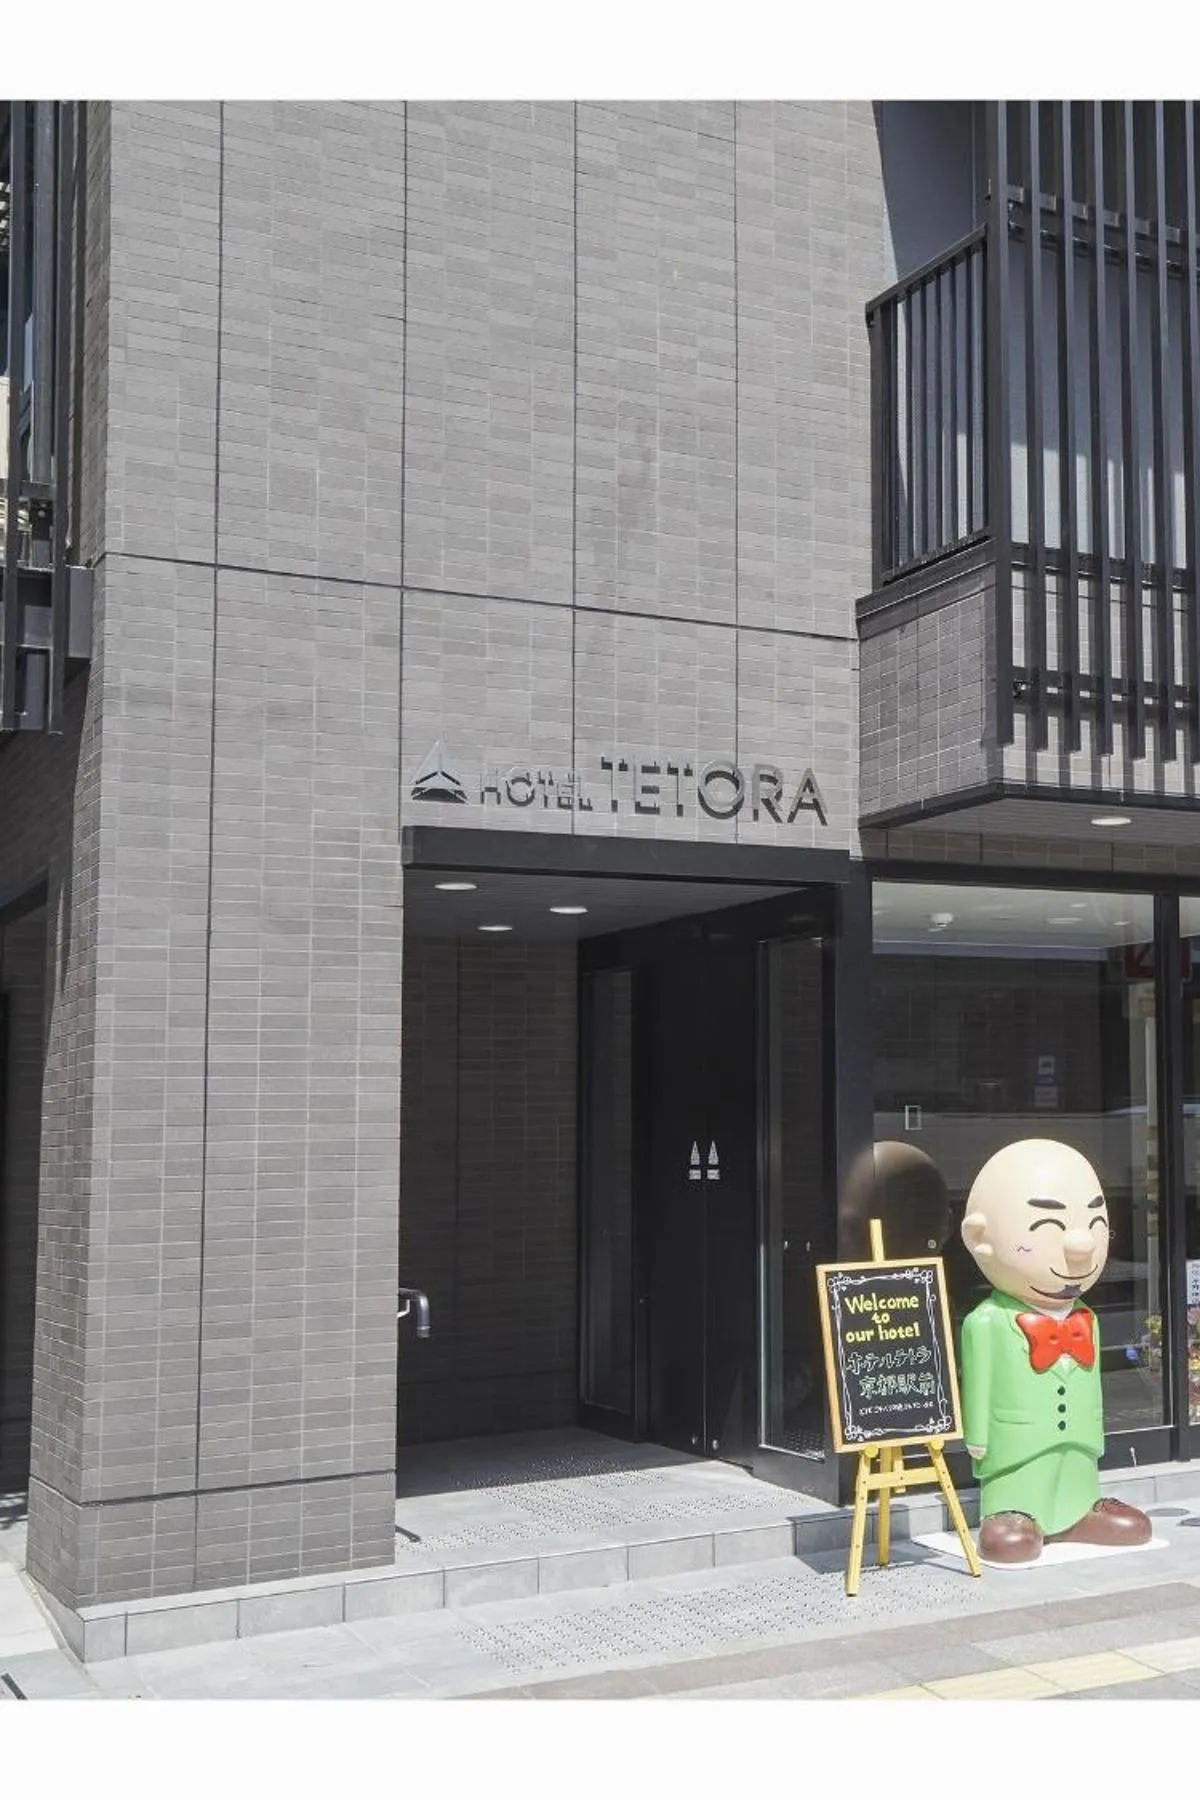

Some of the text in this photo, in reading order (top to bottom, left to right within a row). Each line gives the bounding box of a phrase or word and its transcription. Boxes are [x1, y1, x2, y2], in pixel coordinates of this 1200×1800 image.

[479, 752, 828, 826] HOTEL TETORA
[844, 1292, 919, 1314] Welcome
[871, 1312, 890, 1323] to
[845, 1322, 920, 1343] our hotel
[846, 1346, 931, 1375] ホテルテトラ
